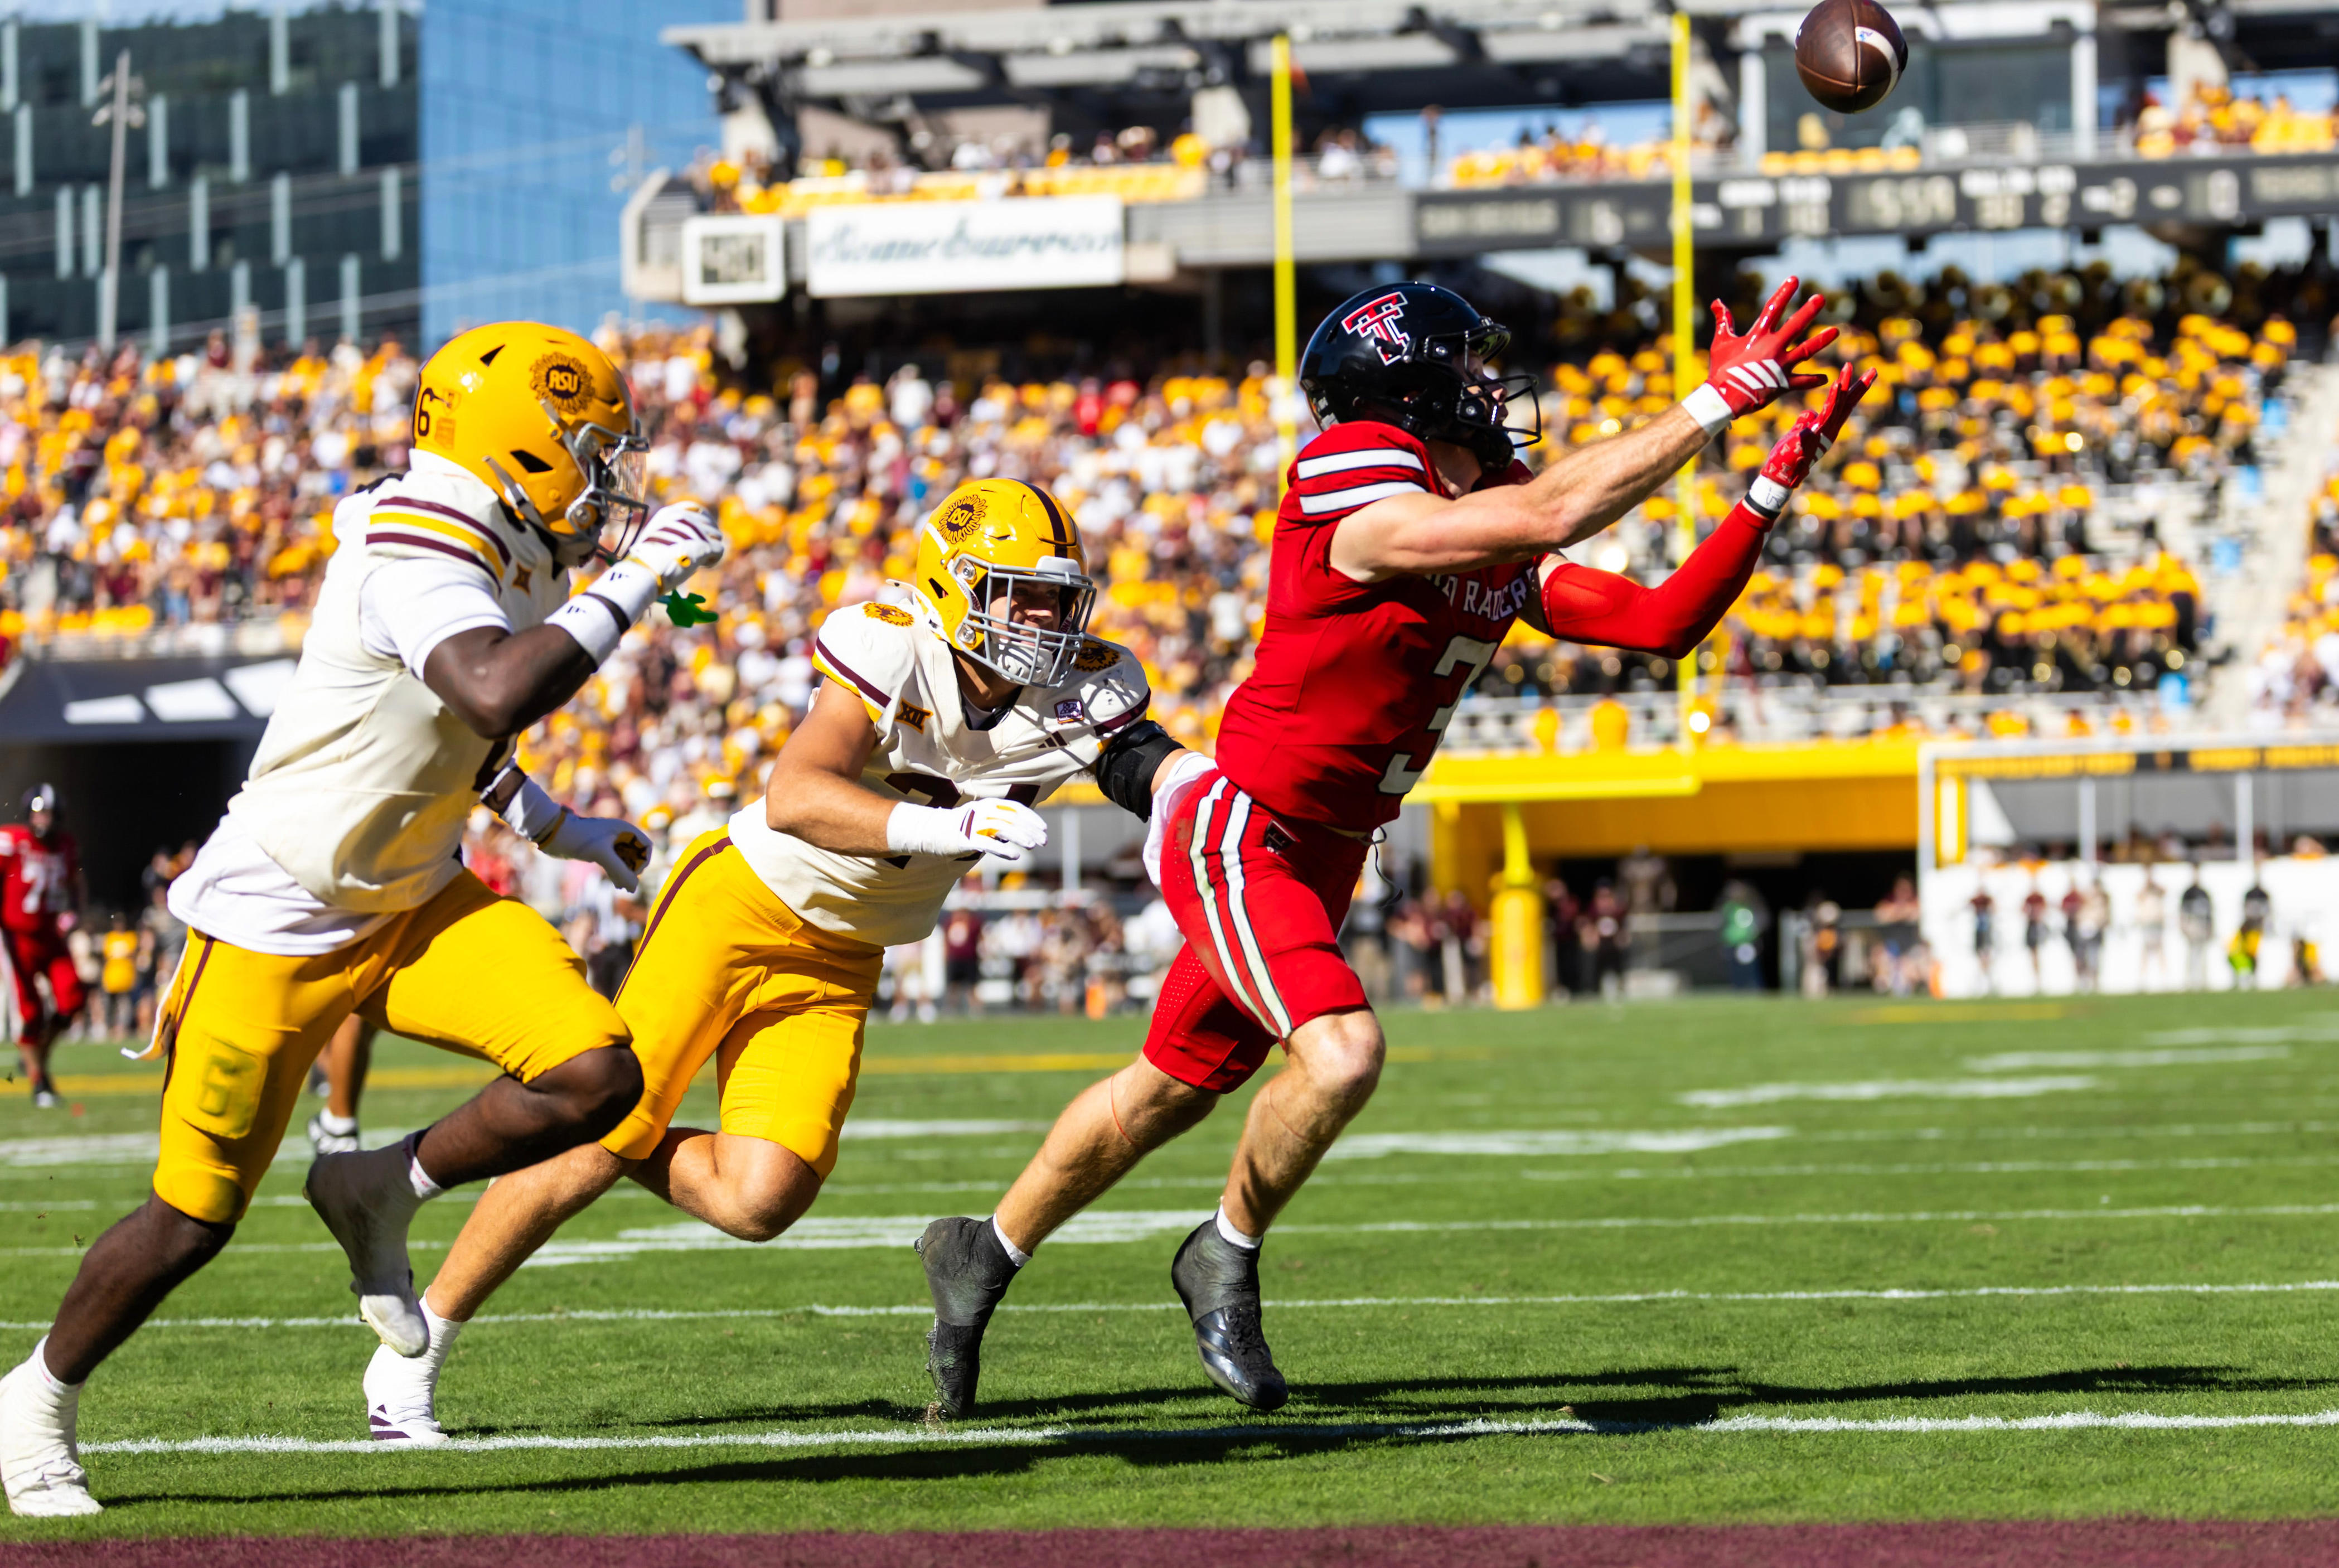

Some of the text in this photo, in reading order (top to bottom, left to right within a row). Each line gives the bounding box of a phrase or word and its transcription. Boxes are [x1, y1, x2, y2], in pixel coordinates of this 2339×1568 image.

[549, 369, 578, 394] ASU
[418, 387, 434, 437] 6
[947, 507, 973, 527] ASU
[894, 698, 933, 734] XII
[1378, 635, 1498, 794] 3
